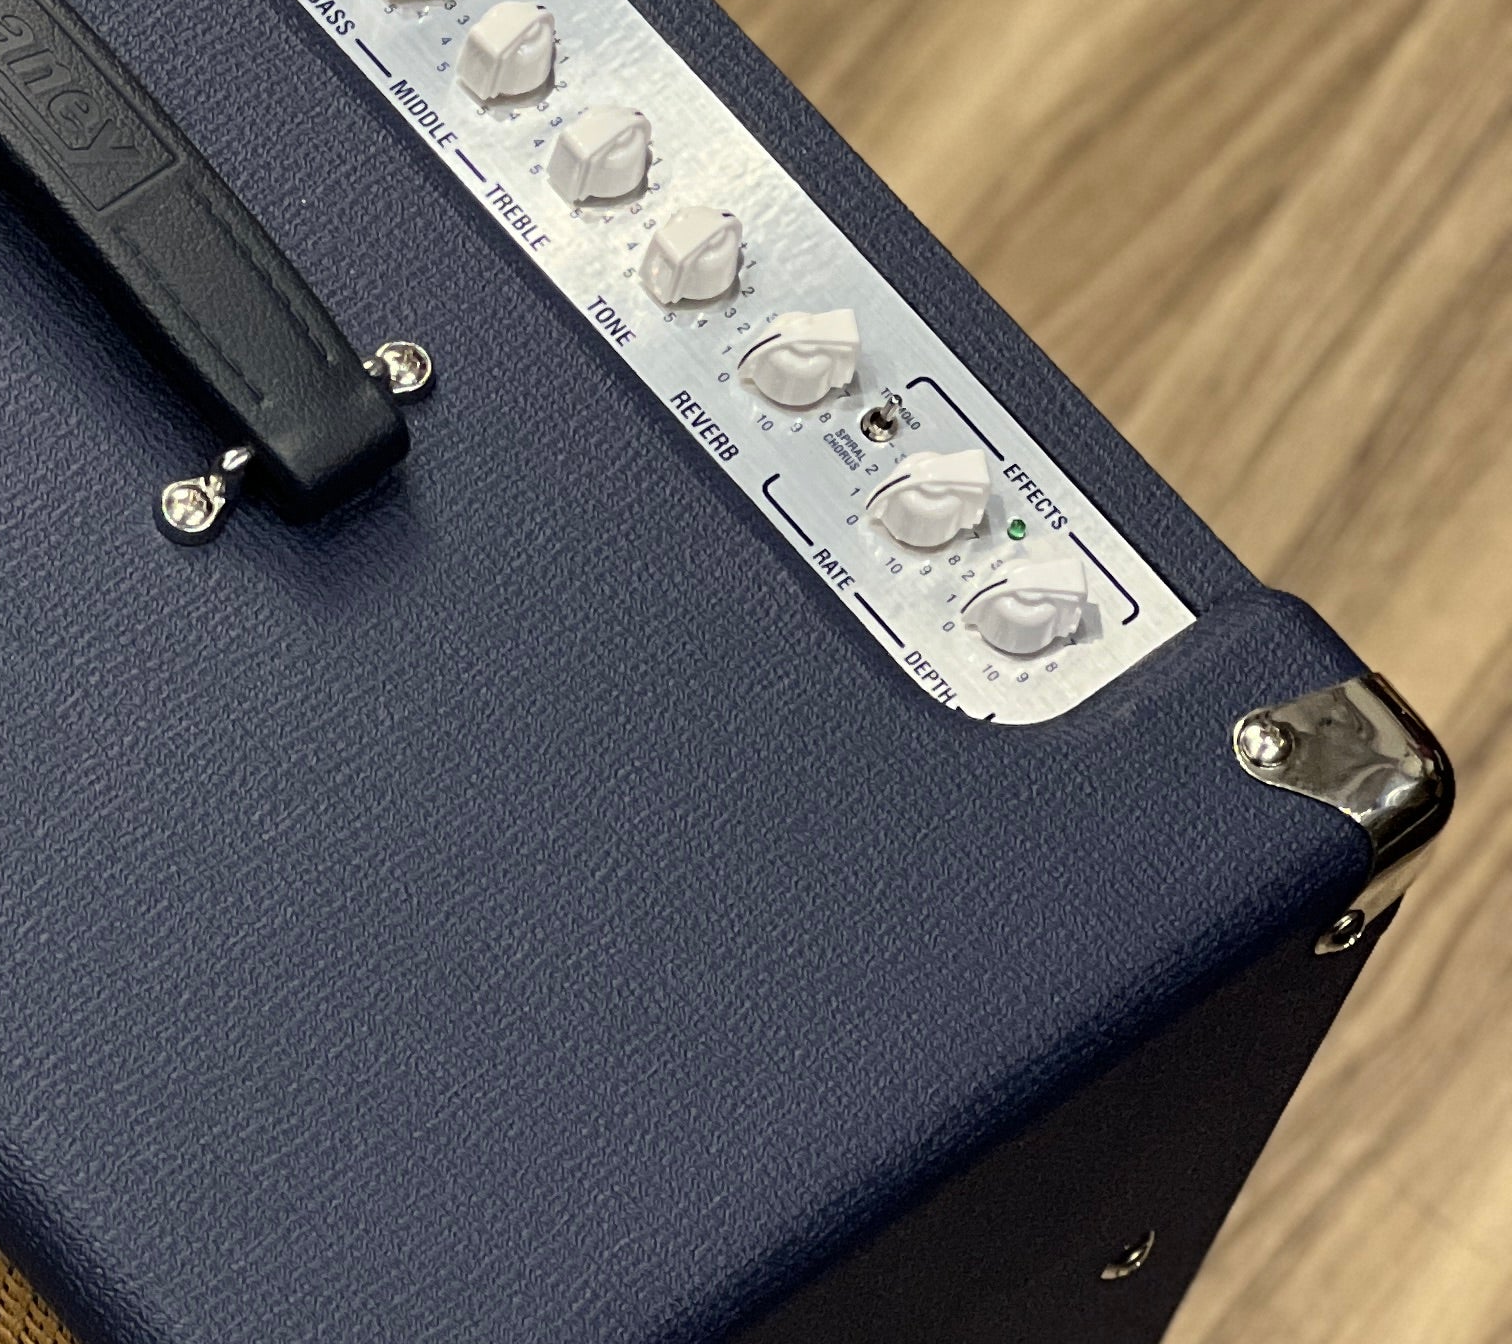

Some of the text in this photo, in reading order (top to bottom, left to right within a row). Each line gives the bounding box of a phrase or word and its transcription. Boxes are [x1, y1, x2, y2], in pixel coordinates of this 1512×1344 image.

[389, 79, 458, 150] MIDDLE
[485, 183, 552, 252] TREBLE
[587, 295, 637, 348] TONE
[670, 390, 740, 462] REVERB
[823, 433, 860, 471] CHORUS
[835, 428, 867, 462] SPIRAL
[1002, 463, 1068, 530] EFFECTS
[813, 548, 856, 591] RATE
[904, 650, 958, 704] DEPTH
